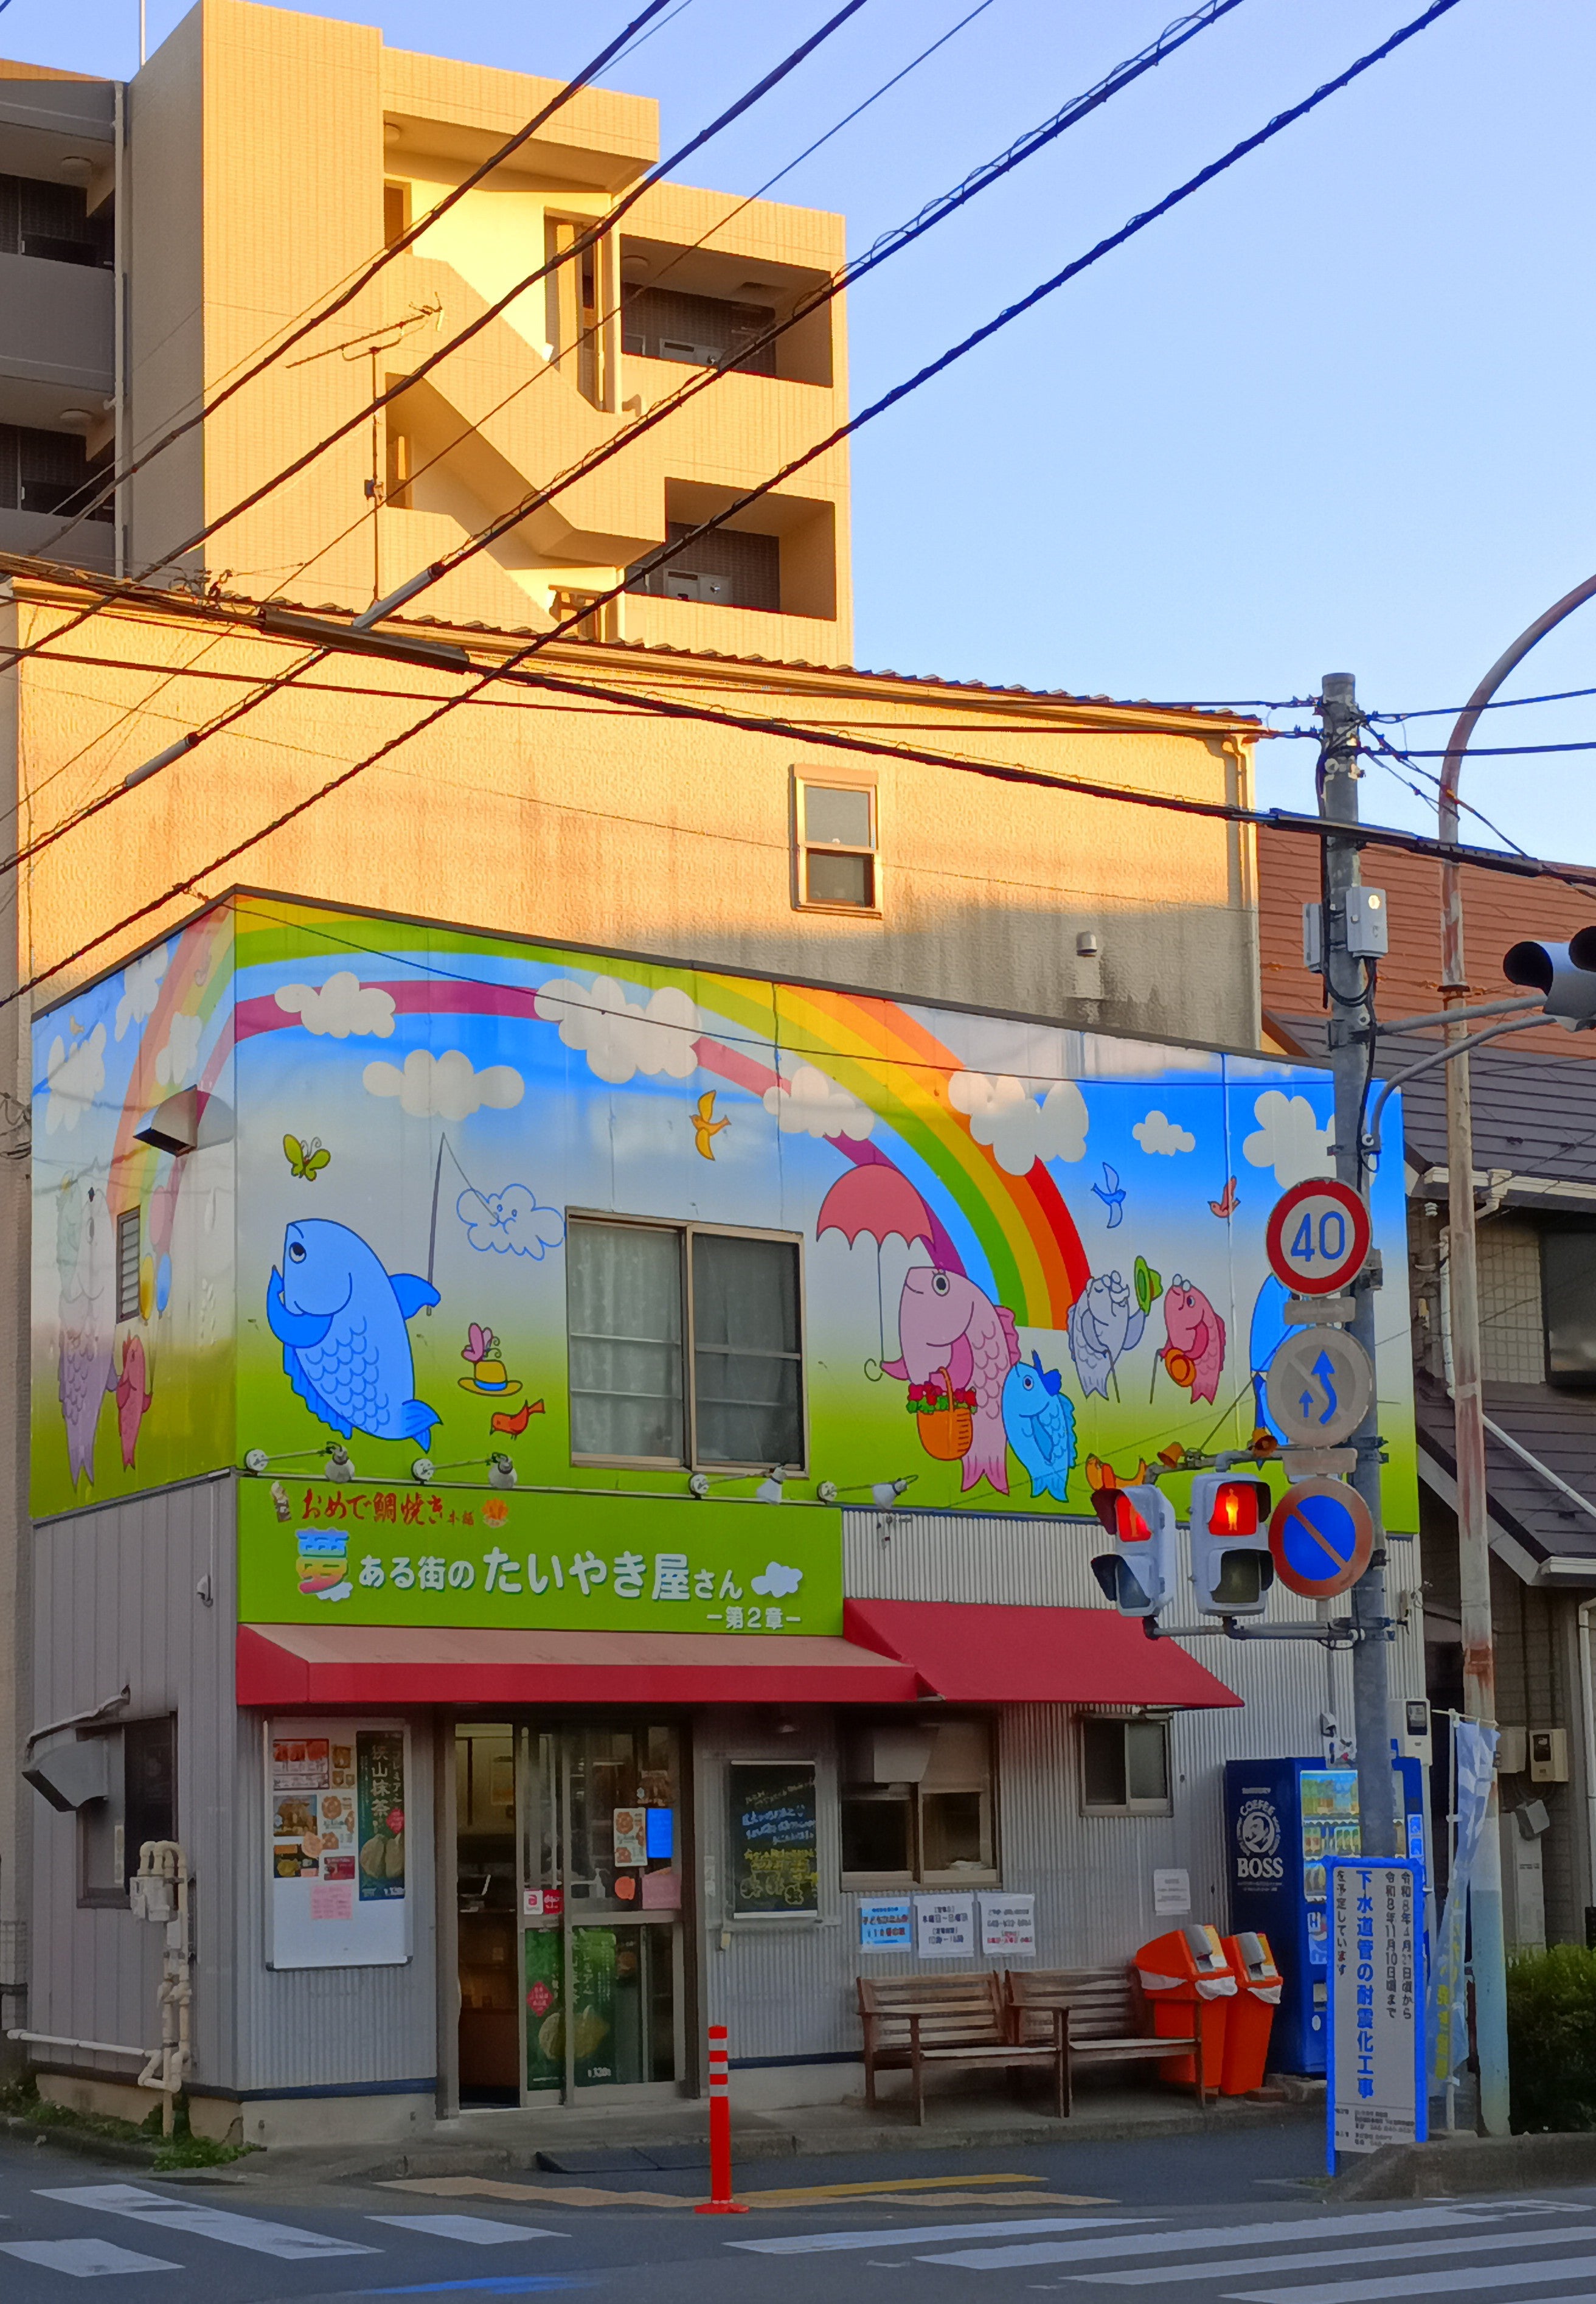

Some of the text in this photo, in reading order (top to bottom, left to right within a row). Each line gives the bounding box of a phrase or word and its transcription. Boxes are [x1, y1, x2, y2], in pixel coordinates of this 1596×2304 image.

[1291, 1211, 1345, 1262] 40
[1240, 1799, 1276, 1817] COFFEE
[1237, 1857, 1283, 1878] BOSS
[1356, 1870, 1374, 2098] 下水道管の耐震化工事
